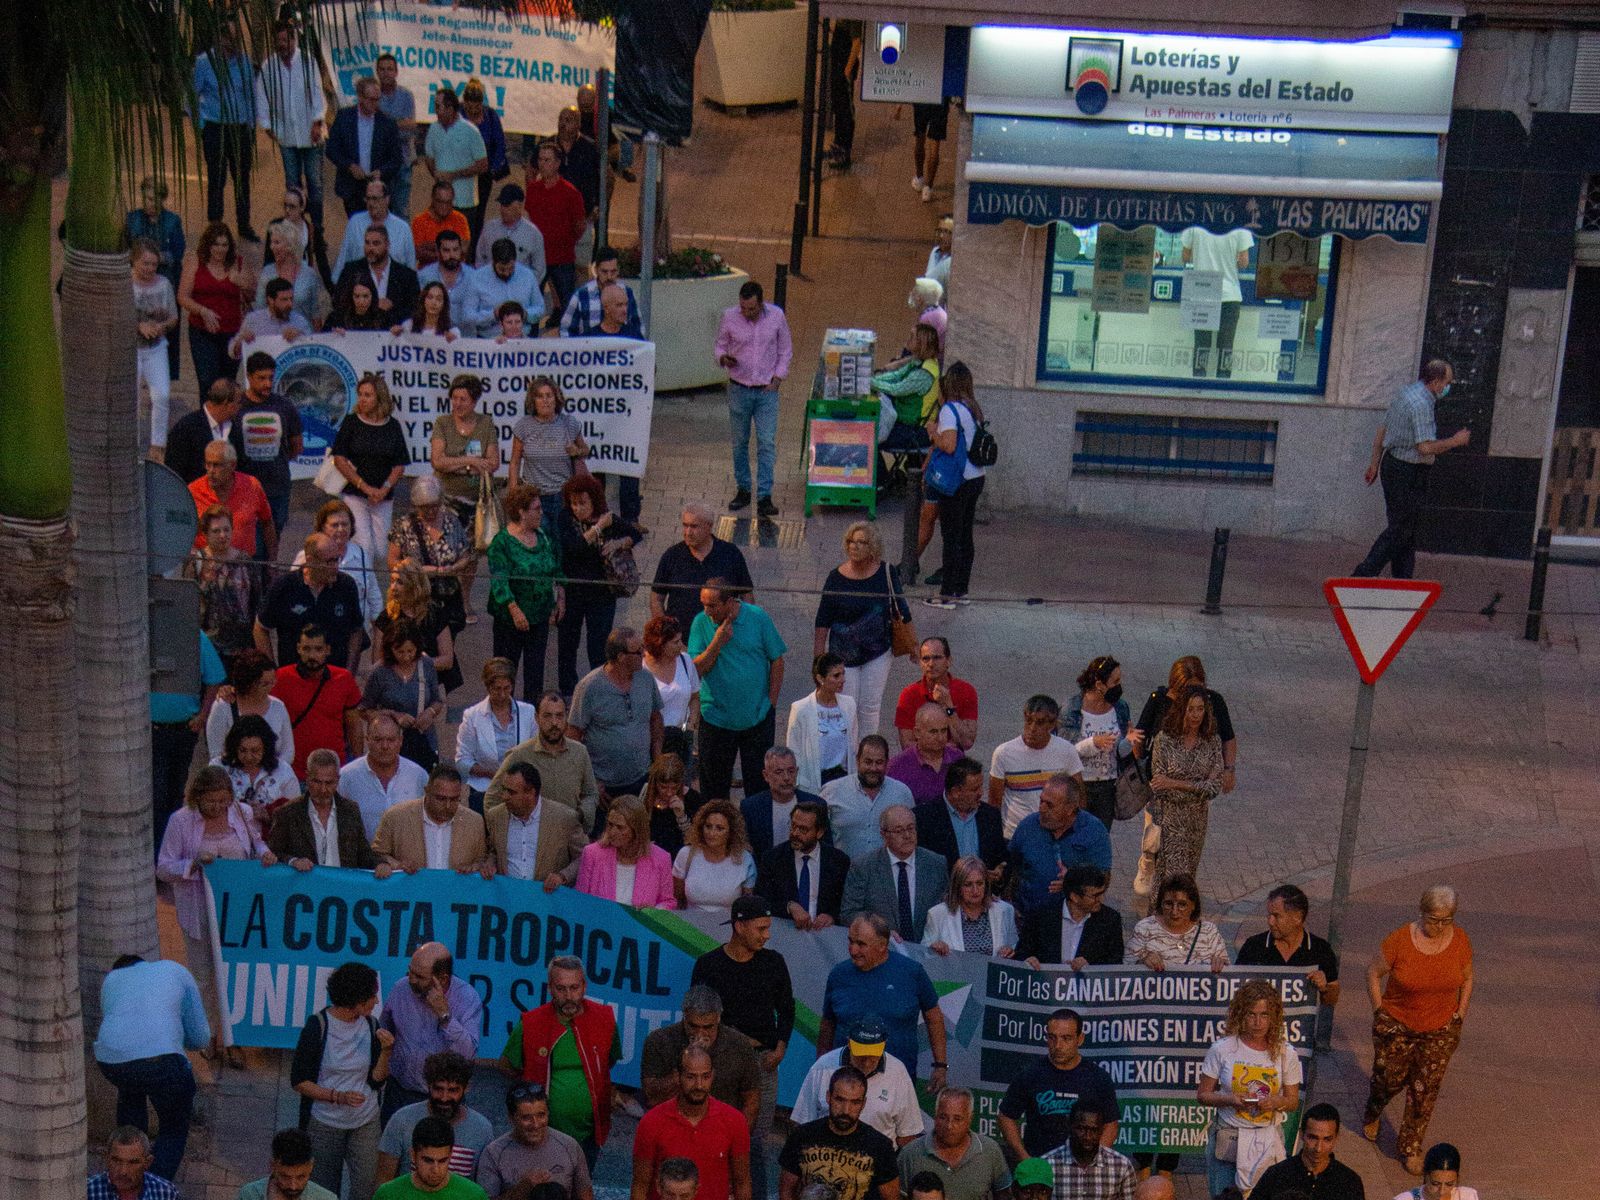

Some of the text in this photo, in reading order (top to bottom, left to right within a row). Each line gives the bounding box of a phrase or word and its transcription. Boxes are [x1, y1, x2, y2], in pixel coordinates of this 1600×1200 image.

[1130, 46, 1240, 75] Loterías y
[1129, 74, 1354, 103] Apuestas del Estado
[1144, 106, 1161, 118] Las
[1168, 107, 1216, 121] Palmeras
[1127, 123, 1292, 143] del Estado
[972, 188, 1053, 218] ADMÓN.
[1059, 197, 1088, 219] DE
[1096, 194, 1195, 223] LOTERÍAS
[1272, 200, 1313, 228] "LAS
[1321, 201, 1429, 232] PALMERAS"
[377, 345, 634, 369] JUSTAS REIVINDICACIONES:
[409, 396, 430, 413] EL
[483, 400, 517, 417] LOS
[219, 892, 672, 997] LA COSTA TROPICAL
[998, 970, 1024, 997] Por
[1027, 974, 1050, 1000] las
[1055, 976, 1211, 1002] CANALIZACIONES
[998, 1013, 1025, 1039] Por
[1082, 1018, 1159, 1043] PIGONES
[1163, 1019, 1187, 1042] EN
[1139, 1127, 1157, 1145] DE
